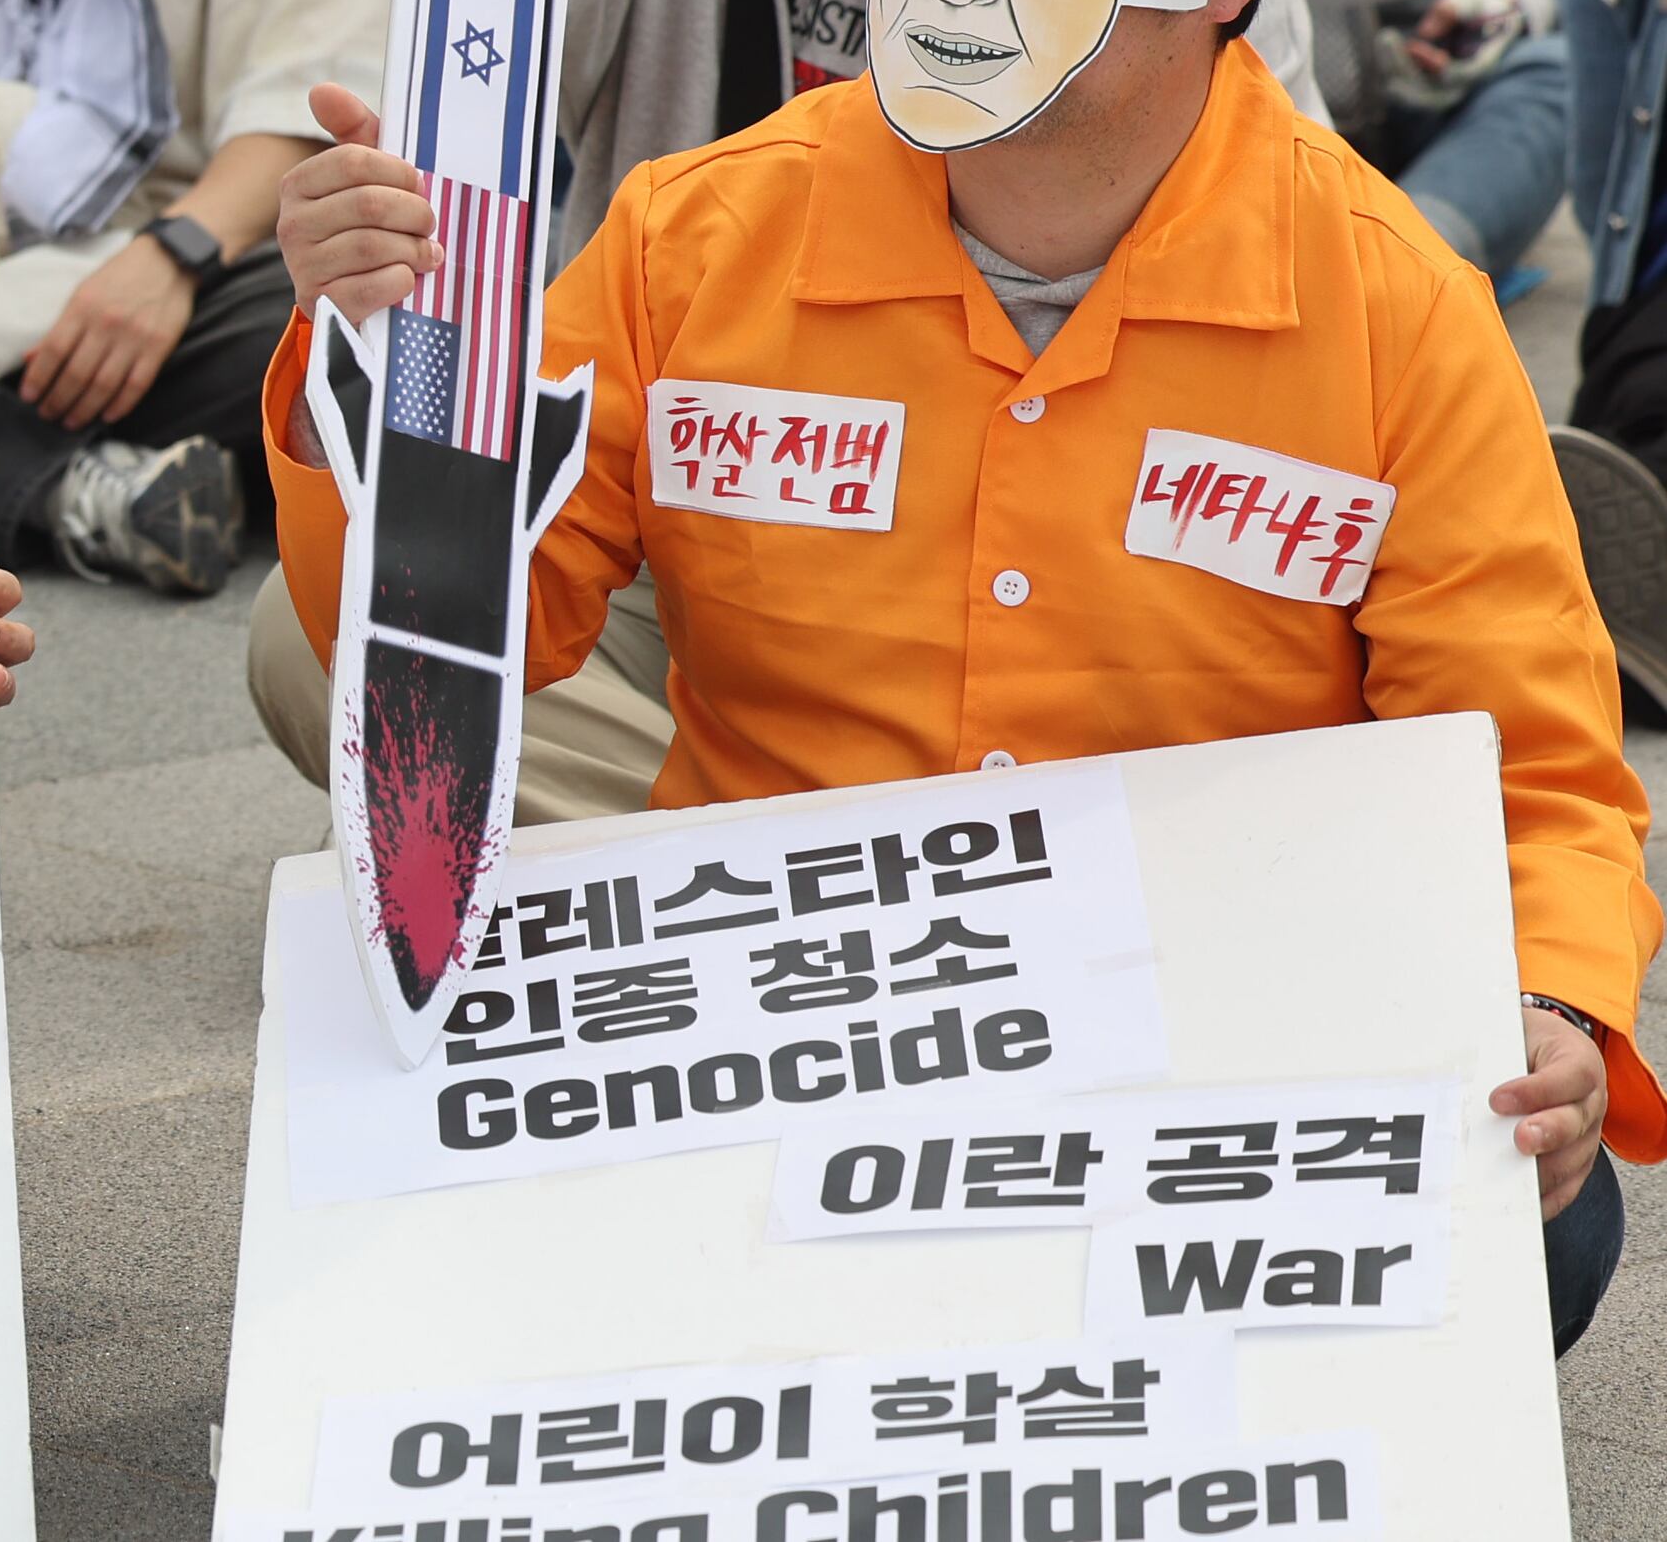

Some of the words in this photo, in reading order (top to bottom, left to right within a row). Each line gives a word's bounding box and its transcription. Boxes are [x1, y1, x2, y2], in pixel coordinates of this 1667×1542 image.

[1142, 461, 1376, 598] 네타냐후
[442, 957, 698, 1065] 인종
[749, 916, 1018, 1013] 청소
[438, 1005, 1052, 1150] Genocide
[821, 1132, 1103, 1214] 이란
[1147, 1115, 1424, 1204] 공격
[1136, 1239, 1412, 1316] War
[390, 1385, 811, 1488] 어린이
[871, 1359, 1160, 1445] 학살
[755, 1458, 1351, 1542] Children
